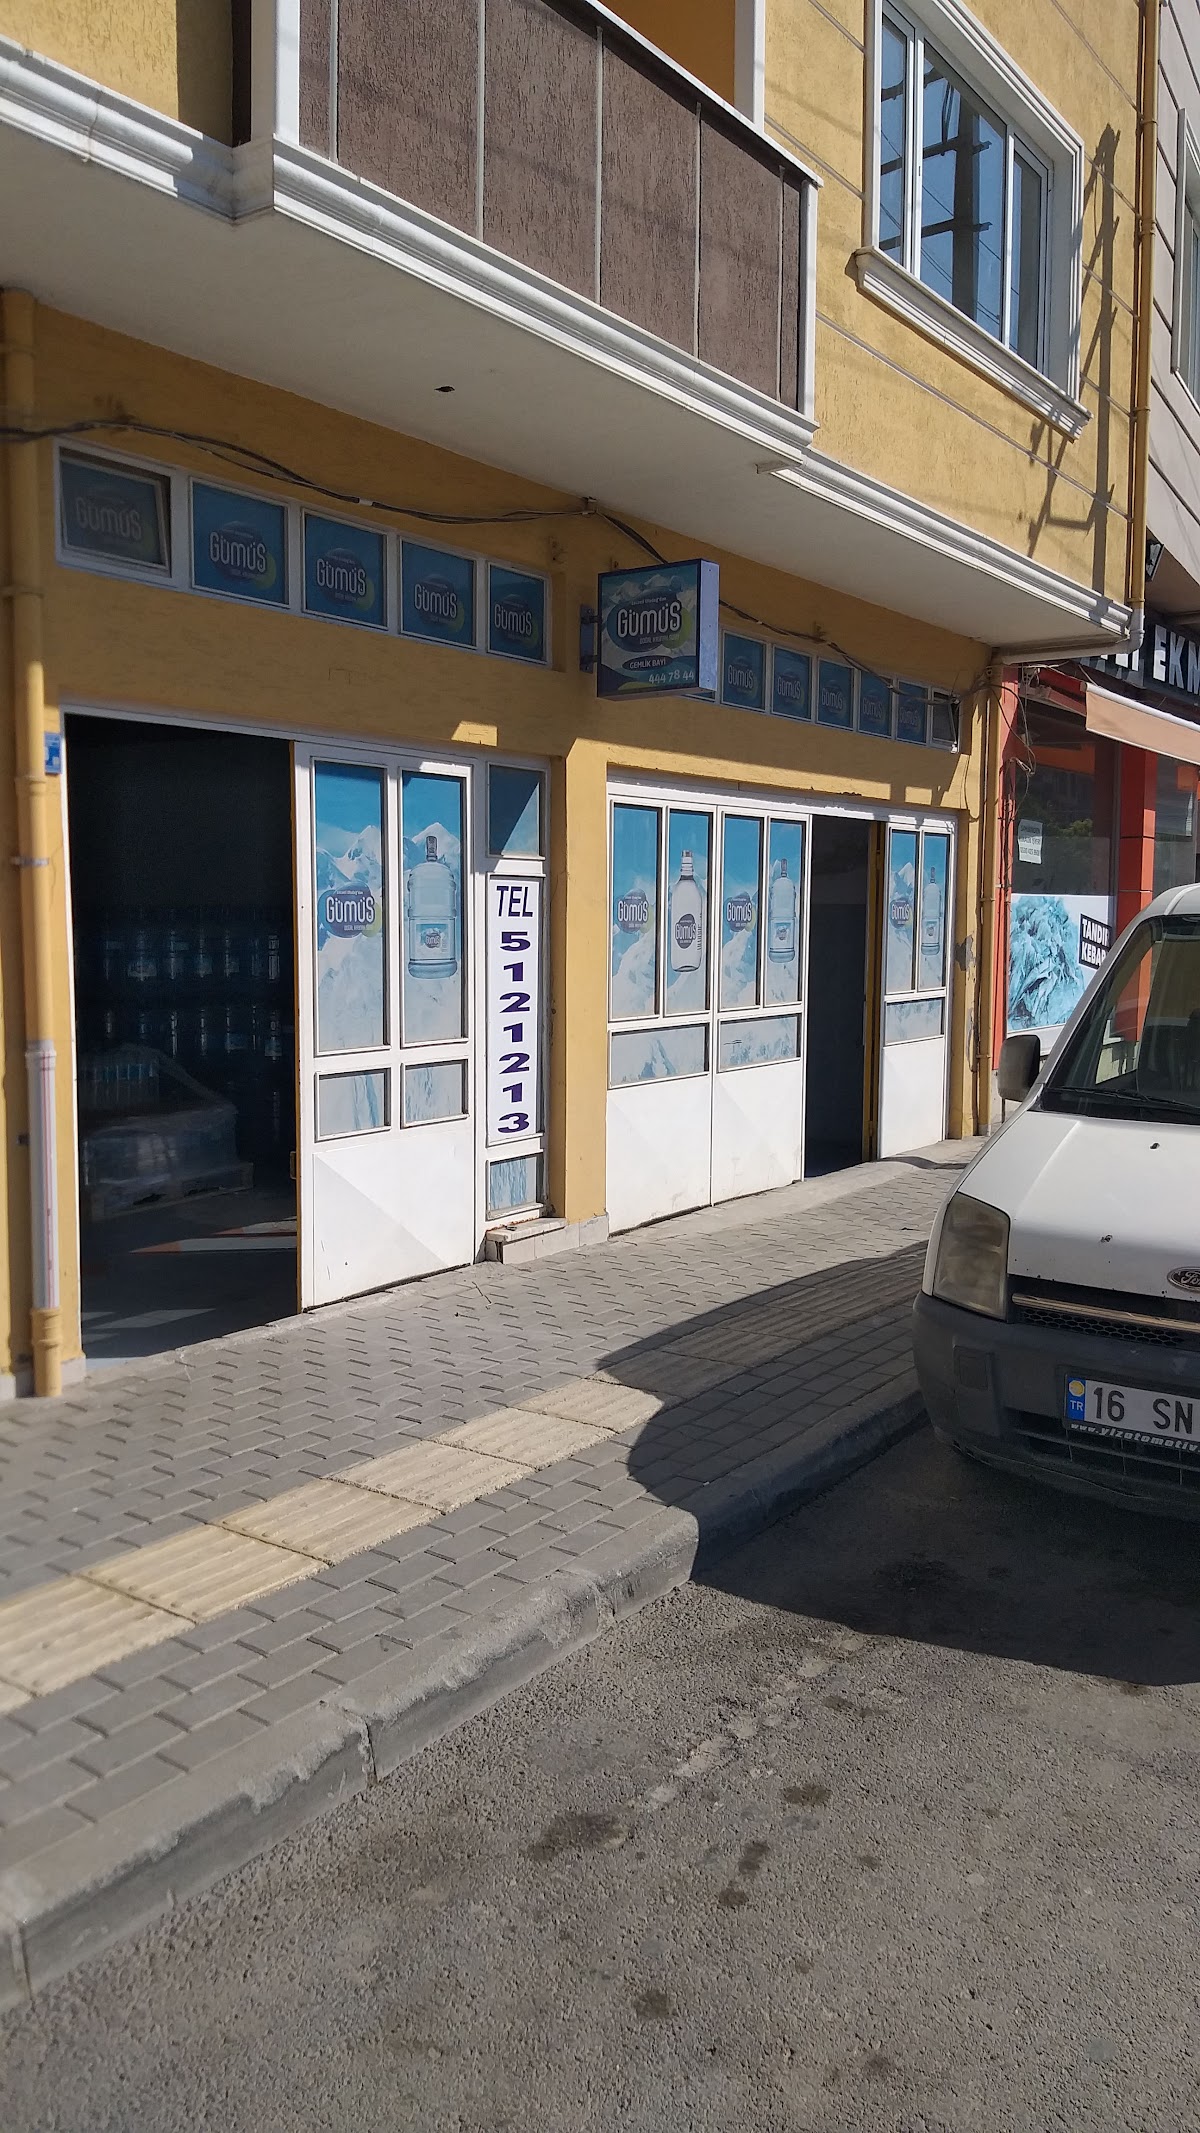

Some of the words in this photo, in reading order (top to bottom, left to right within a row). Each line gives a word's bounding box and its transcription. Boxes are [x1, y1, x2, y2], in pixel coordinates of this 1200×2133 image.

[648, 674, 666, 684] 444
[668, 669, 680, 682] 78
[682, 670, 694, 680] 44
[495, 885, 533, 918] TEL
[1070, 1400, 1084, 1411] TR
[1093, 1387, 1125, 1422] 16
[1152, 1398, 1193, 1434] SN
